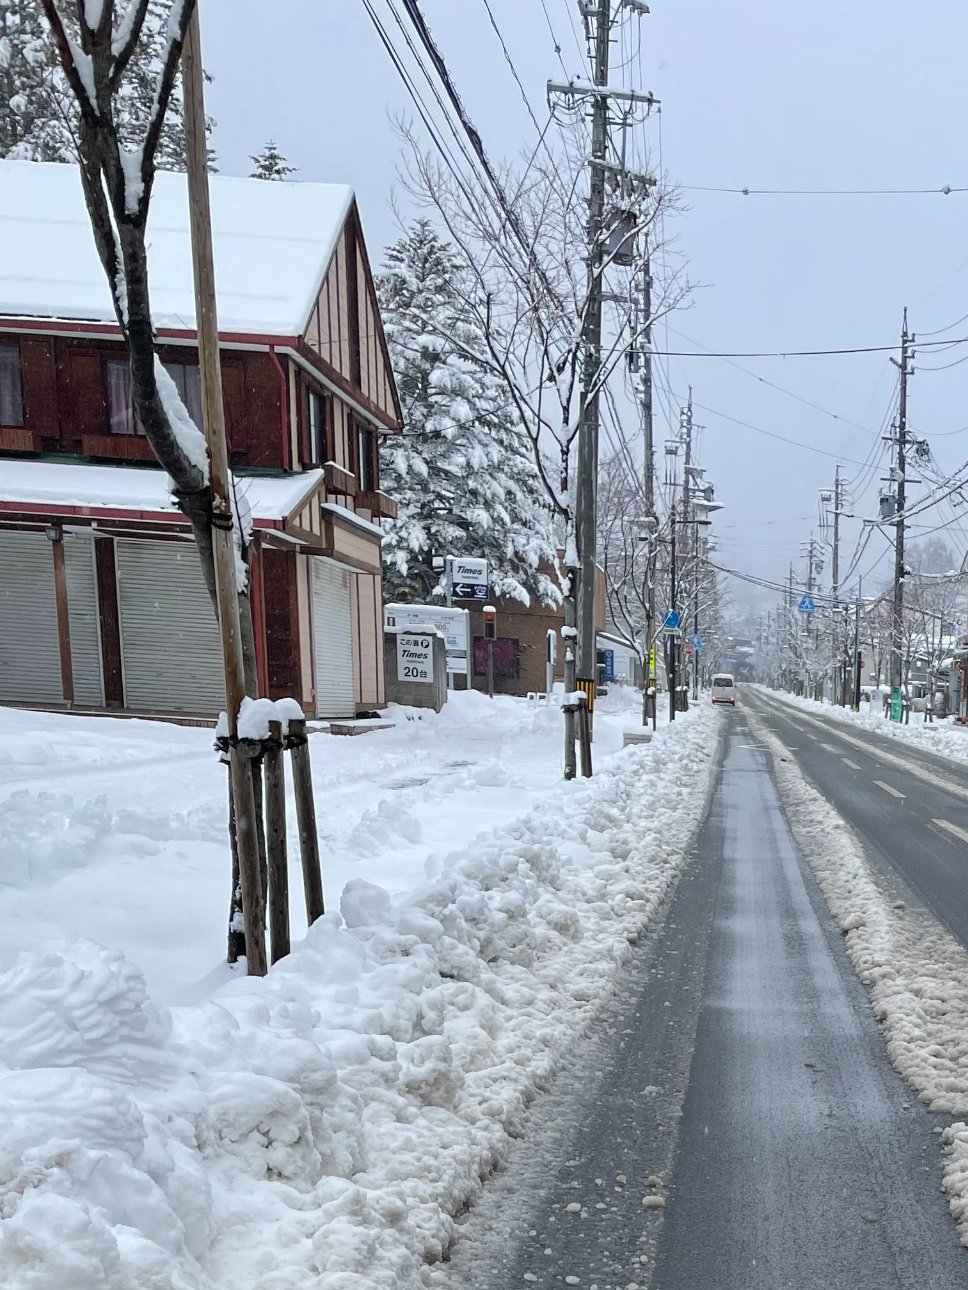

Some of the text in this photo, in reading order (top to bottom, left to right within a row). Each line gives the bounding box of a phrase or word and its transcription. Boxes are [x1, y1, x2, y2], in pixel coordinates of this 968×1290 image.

[457, 565, 483, 576] Times
[401, 649, 429, 660] Times
[403, 666, 428, 679] 20台
